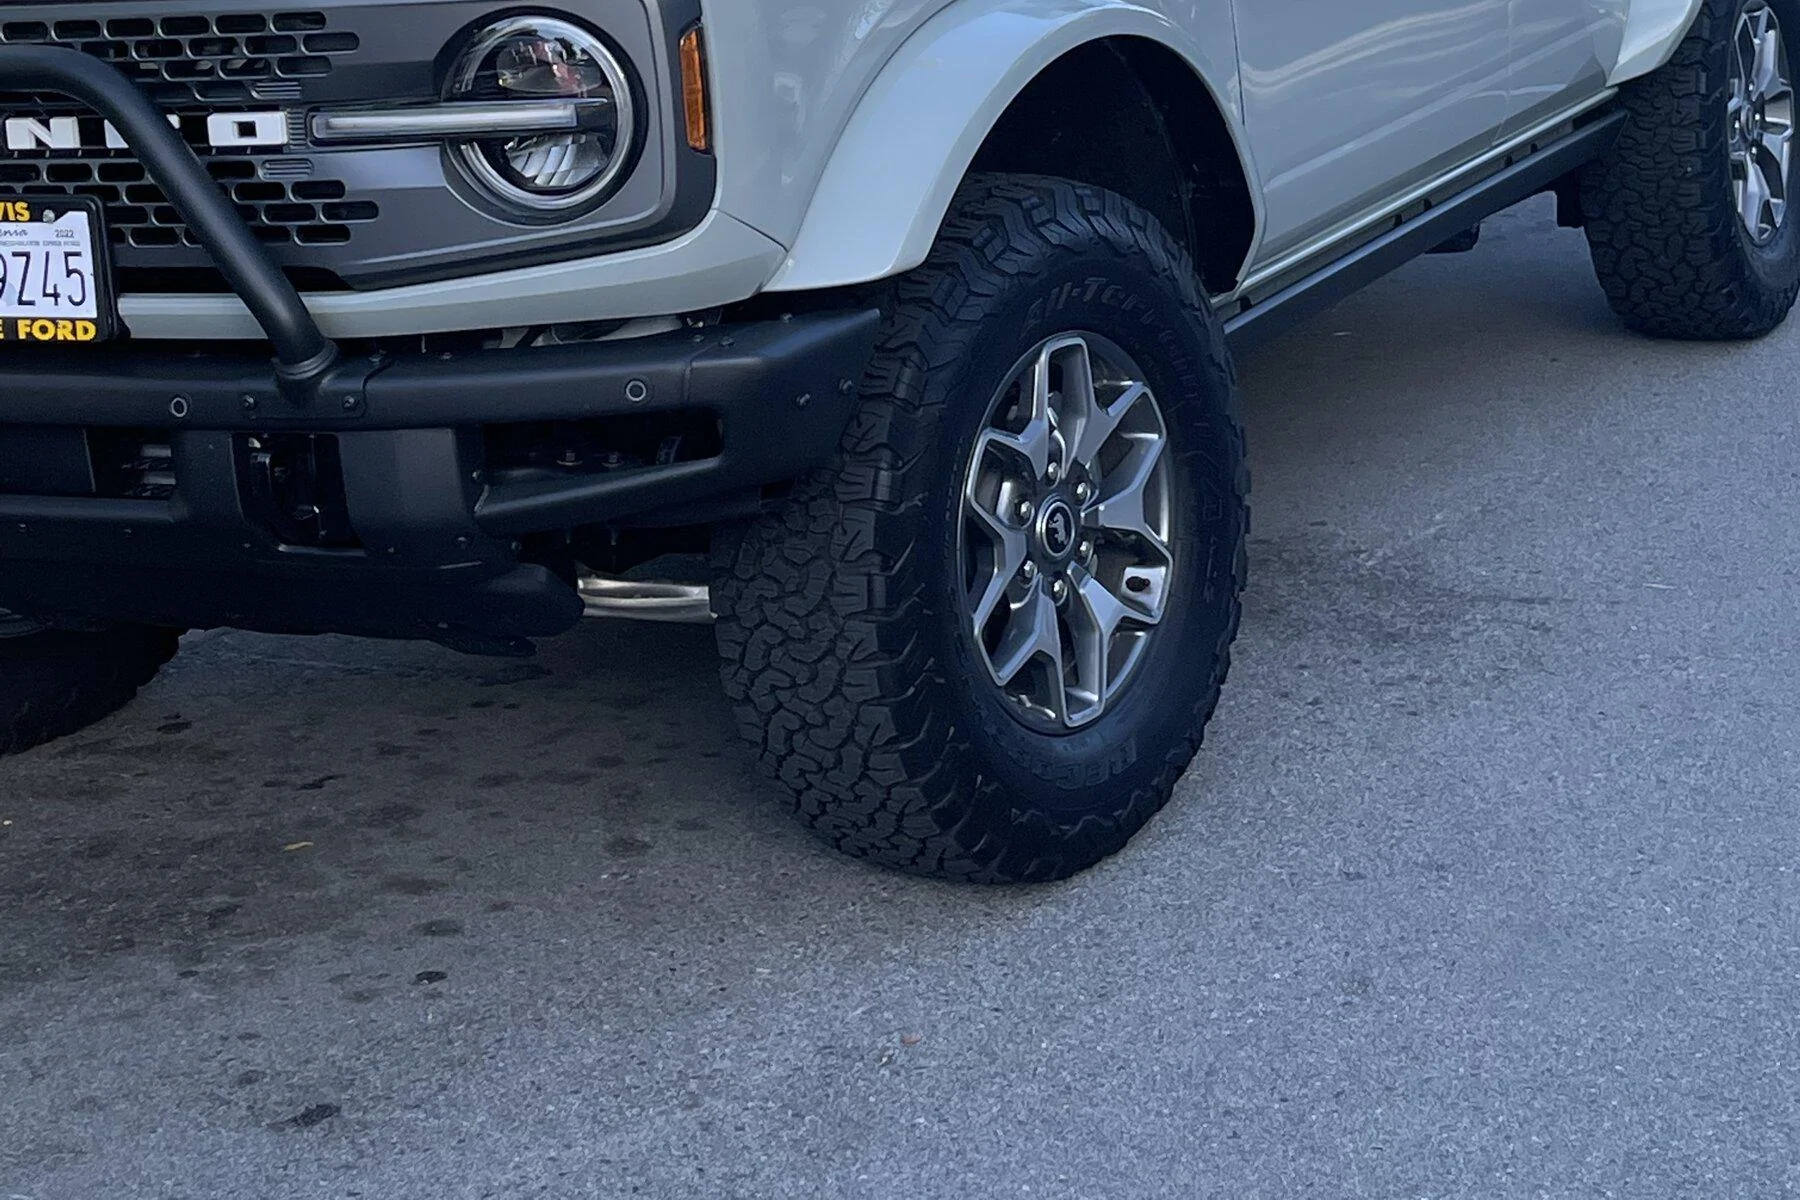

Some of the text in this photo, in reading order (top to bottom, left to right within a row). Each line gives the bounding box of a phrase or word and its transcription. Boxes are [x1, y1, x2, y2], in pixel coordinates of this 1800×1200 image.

[5, 110, 290, 150] NO
[54, 228, 75, 239] 2022
[17, 318, 97, 341] FORD
